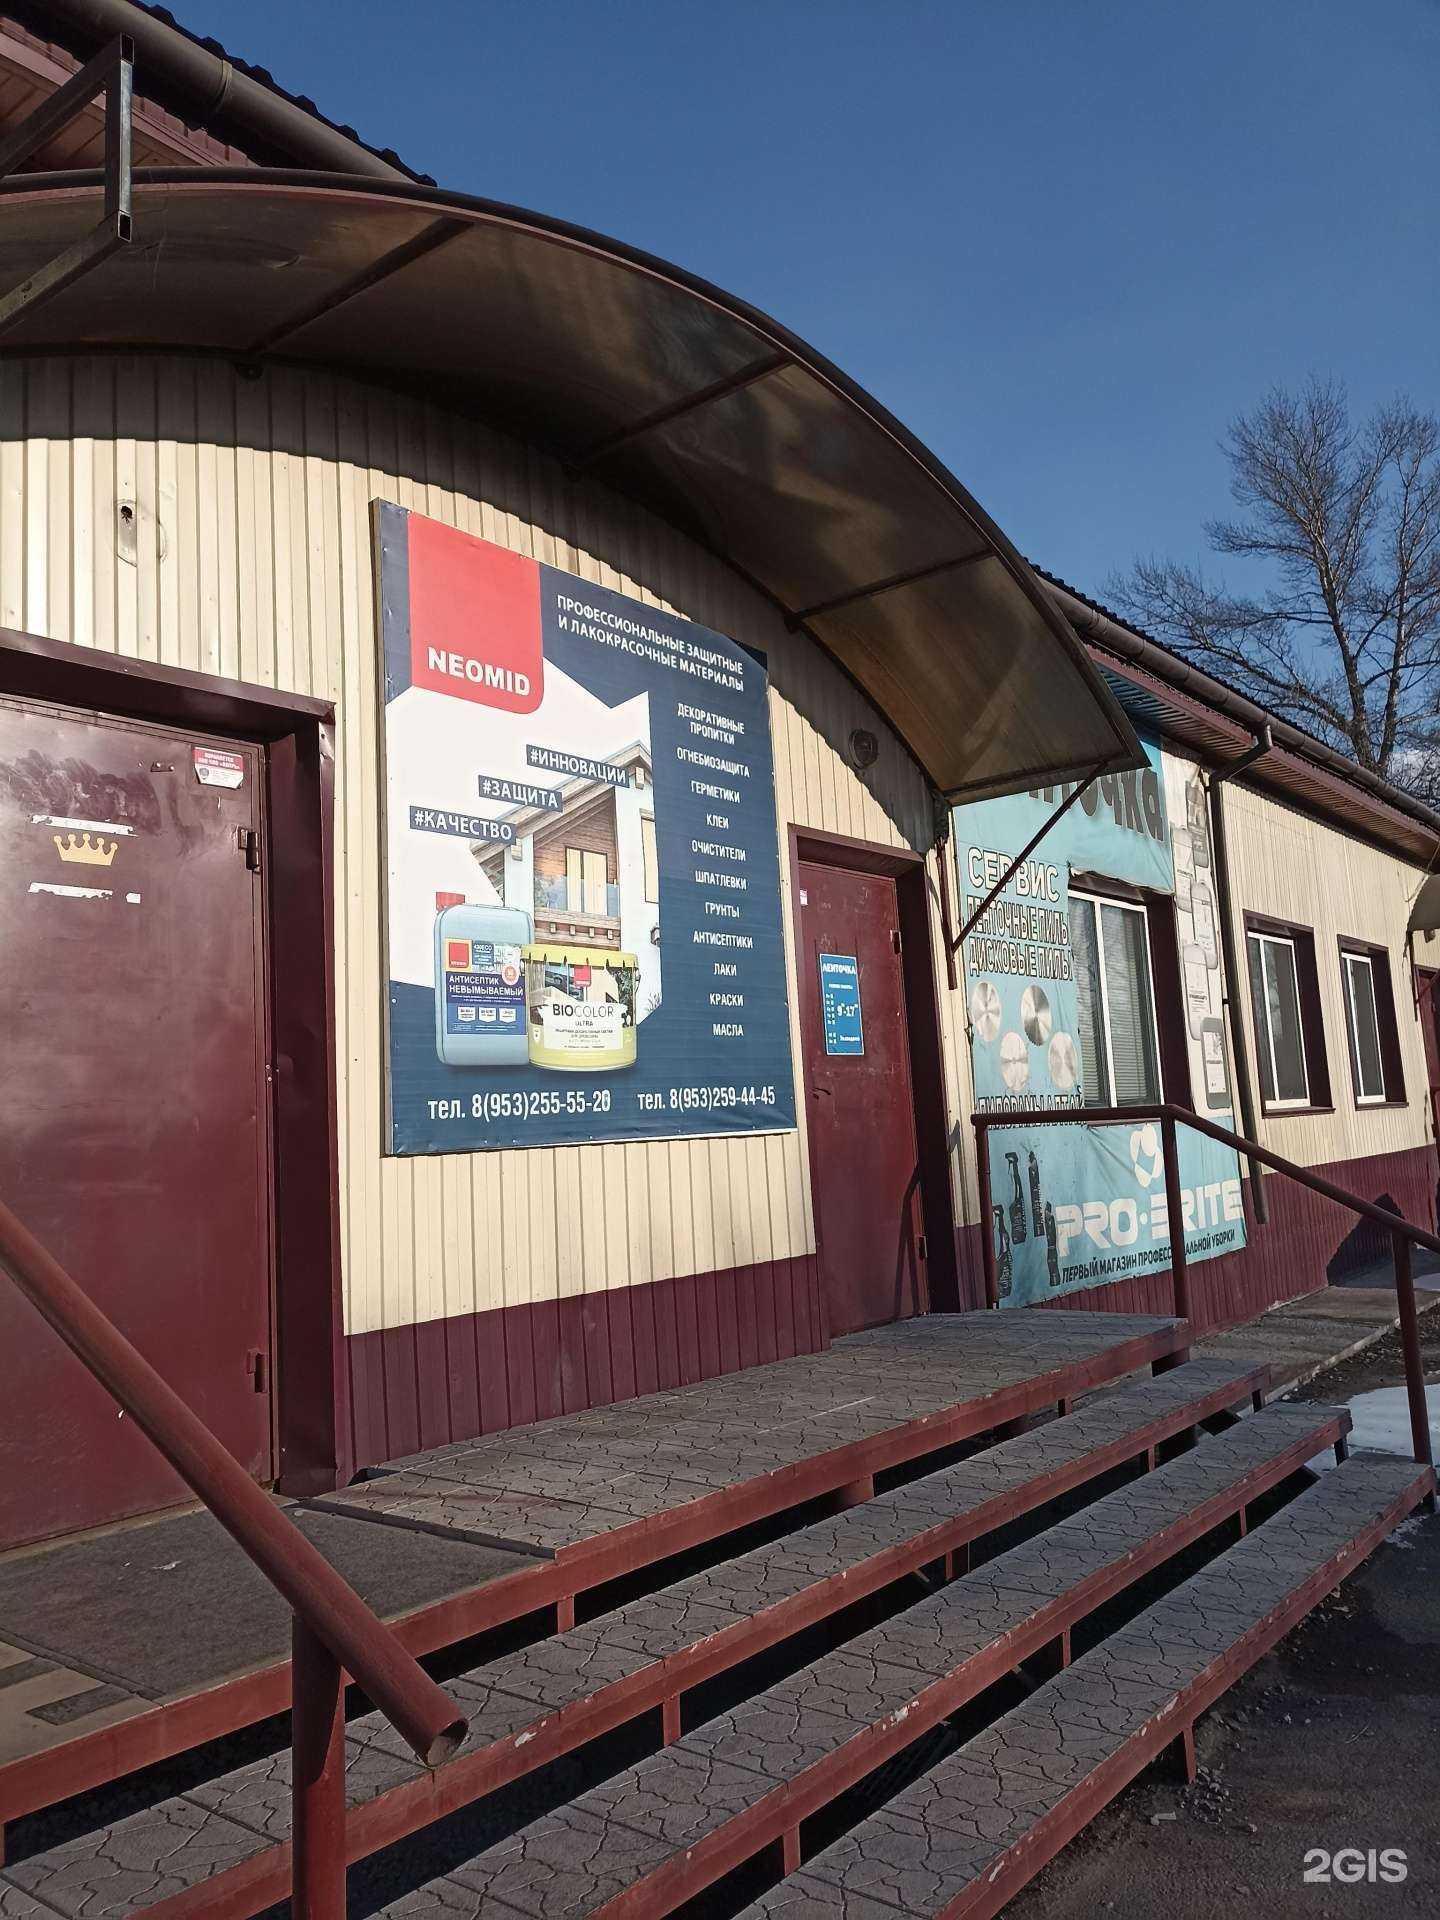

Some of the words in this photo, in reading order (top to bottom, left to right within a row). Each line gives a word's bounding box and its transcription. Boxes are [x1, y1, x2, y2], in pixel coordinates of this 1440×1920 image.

[557, 594, 685, 654] ПРОФЕССИОНАЛЬНЫЕ
[686, 643, 743, 675] ЗАЩИТНЫЕ
[558, 614, 568, 630] И
[571, 616, 677, 668] ЛАКОКРАСОЧНЫЕ
[679, 659, 744, 692] МАТЕРИАЛЫ
[427, 646, 531, 696] NEOMID
[677, 702, 745, 735] ДЕКОРАТИВНЫЕ
[690, 722, 735, 745] ПРОПИТКИ
[530, 748, 626, 784] #ИННОВАЦИИ
[677, 747, 751, 778] ОГНЕБИОЗАЩИТА
[482, 779, 558, 809] #ЗАЩИТА
[690, 780, 741, 804] ГЕРМЕТИКИ
[414, 809, 512, 841] #КАЧЕСТВО
[706, 813, 729, 829] КЛЕИ
[691, 839, 746, 862] ОЧИСТИТЕЛИ
[695, 870, 747, 890] ШПАТЛЕВКИ
[967, 846, 1060, 903] СЕРВИС
[704, 901, 740, 918] ГРУНТЫ
[693, 930, 754, 949] АНТИСЕПТИКИ
[713, 962, 737, 976] ЛАКИ
[969, 936, 1037, 978] ДИСКОВЫЕ
[1037, 945, 1075, 982] ПИЛЫ
[448, 975, 500, 985] АНТИСЕПТИК
[449, 984, 524, 996] НЕВЫМЫВАЕМЫЙ
[552, 1003, 614, 1018] BIOCOLOR
[709, 992, 744, 1007] КРАСКИ
[712, 1023, 744, 1036] МАСЛА
[428, 1098, 466, 1120] тел.
[637, 1091, 666, 1111] тел.
[669, 1085, 777, 1113] 8(953)259-44-45
[1062, 1256, 1099, 1285] ПЕРВЫЙ
[1099, 1253, 1138, 1273] МАГАЗИН
[1137, 1232, 1212, 1267] ПРОФЕССАЛЬНОЙ
[1211, 1228, 1236, 1249] УБОРКИ
